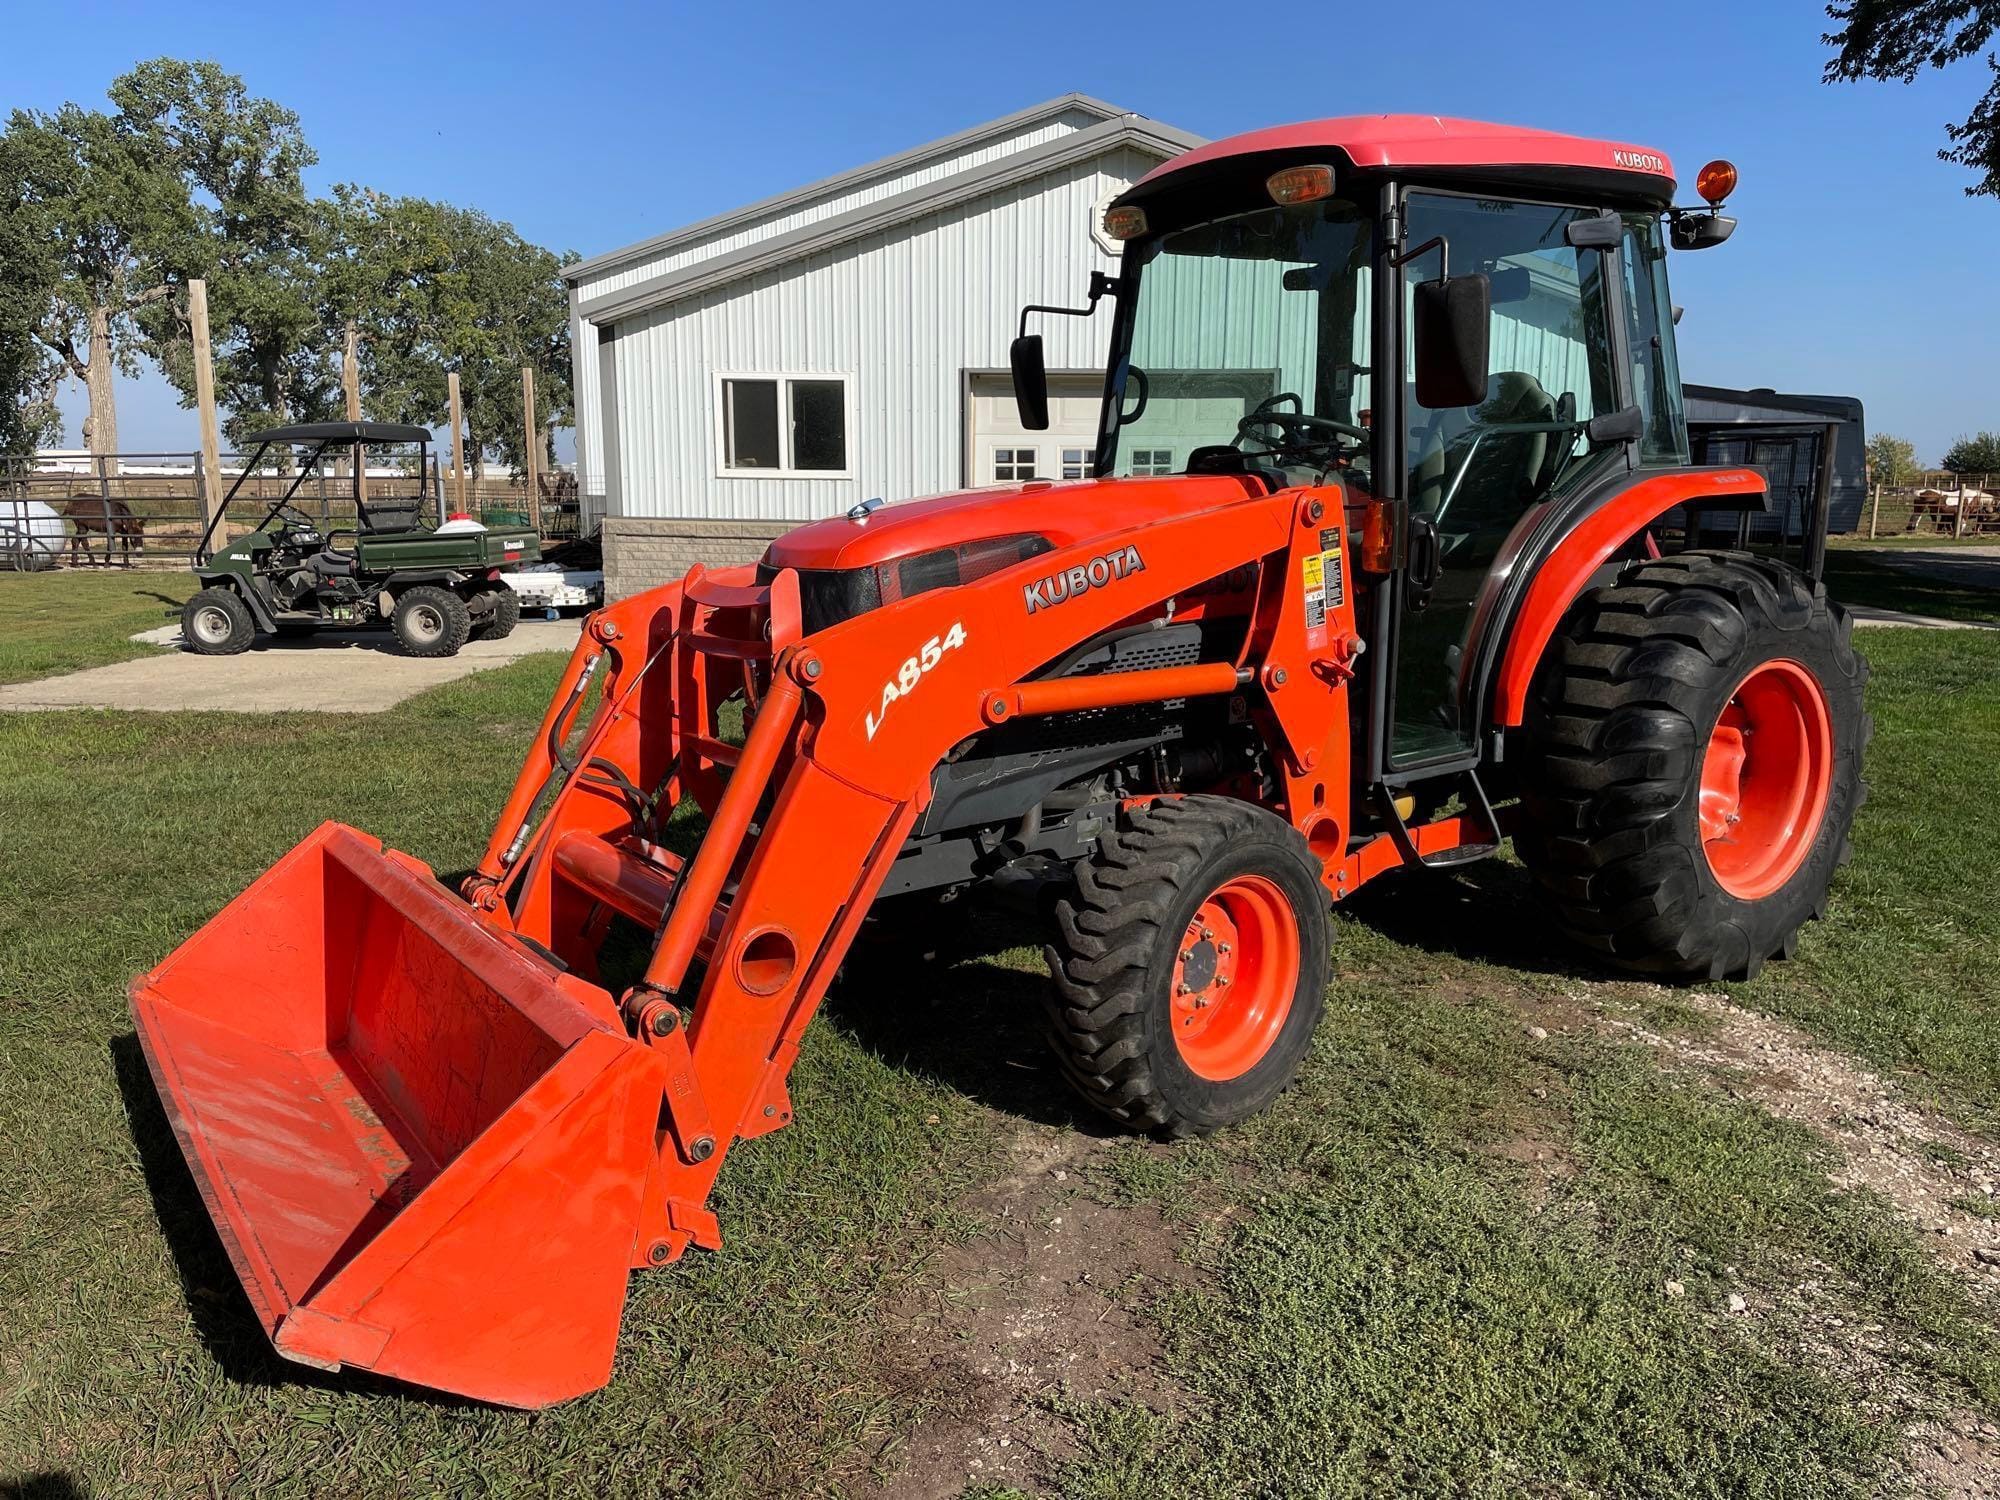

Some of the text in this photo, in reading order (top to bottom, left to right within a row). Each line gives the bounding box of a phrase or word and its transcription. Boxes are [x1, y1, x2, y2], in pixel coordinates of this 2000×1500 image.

[1613, 149, 1665, 171] KUBOTA
[1023, 544, 1146, 615] KUBOTA
[865, 621, 968, 742] LA854
